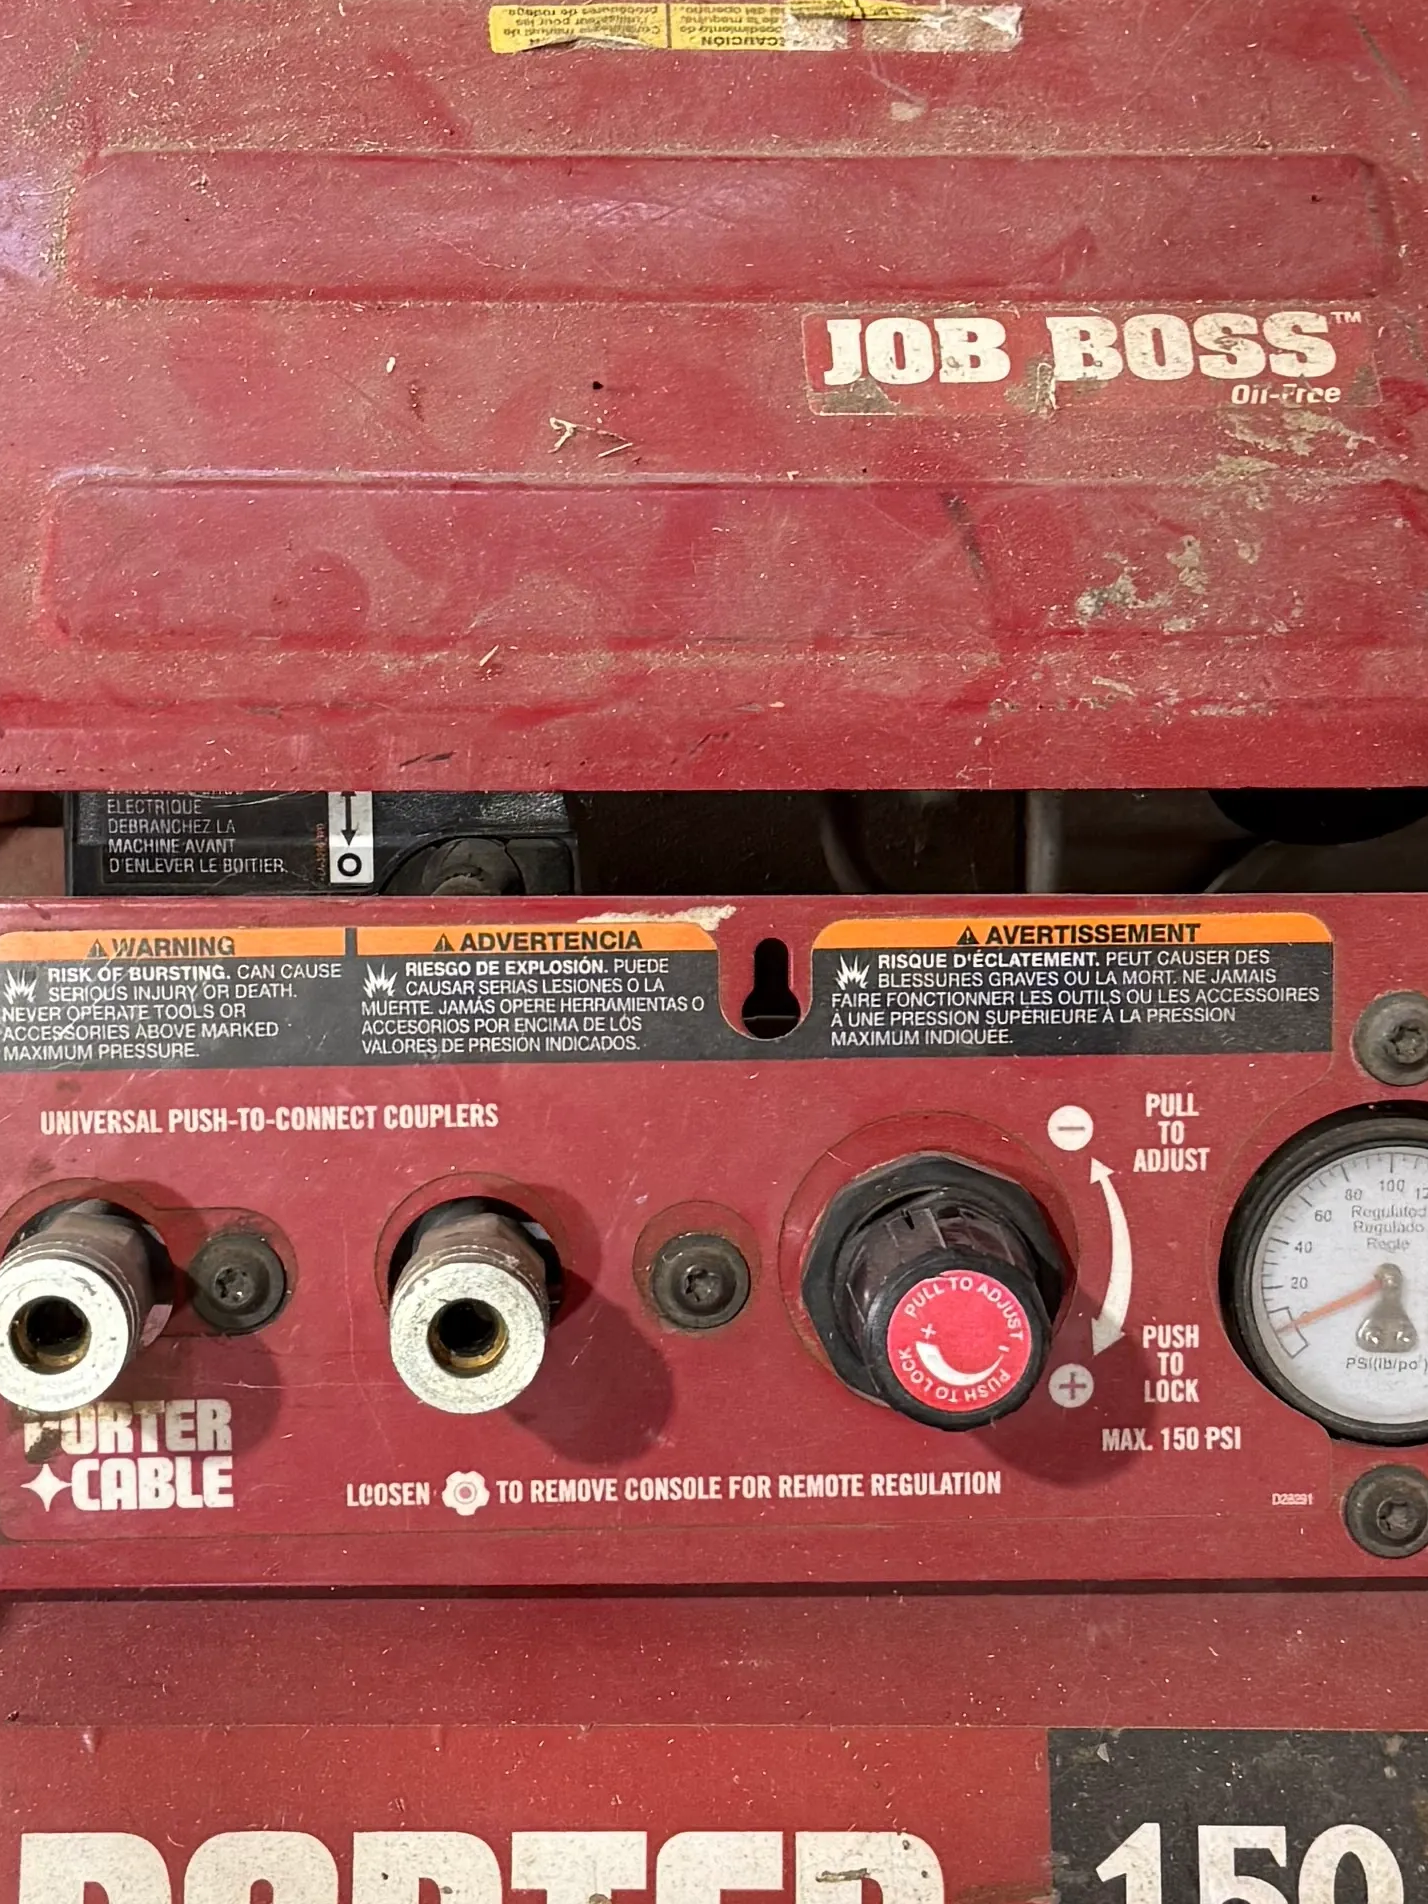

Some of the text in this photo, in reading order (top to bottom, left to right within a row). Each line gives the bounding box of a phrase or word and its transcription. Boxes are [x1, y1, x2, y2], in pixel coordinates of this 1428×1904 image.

[823, 316, 1011, 385] JOB
[108, 818, 236, 835] DEBRANCHEZ LA
[108, 838, 236, 854] MACHINE AVANT
[109, 857, 195, 873] D'ENLEVER
[199, 858, 218, 873] LE
[459, 931, 643, 952] ADVERTENCIA
[985, 923, 1201, 945] AVERTISSEMENT
[111, 936, 236, 957] WARNING
[405, 956, 669, 977] RIESGO DE EXPLOSIÓN. PUEDE
[878, 949, 1270, 969] RISQUE D'ÉCLATEMENT. PEUT CAUSER DES
[48, 963, 342, 983] RISK OF BURSTING. CAN CAUSE
[878, 968, 1277, 989] BLESSURES GRAVES OU LA MORT. NE JAMAIS
[48, 983, 297, 1002] SERIOUS INJURY OR DEATH.
[405, 978, 665, 995] CAUSAR SERIAS LESIONES O LA
[361, 996, 705, 1016] MUERTE. JAMÁS OPERE HERRAMIENTAS O
[831, 987, 1320, 1008] FAIRE FONCTIONNER LES OUTILS OU LES ACCESSOIRES
[2, 1003, 246, 1023] NEVER OPERATE TOOLS OR
[848, 1011, 885, 1027] UNE
[890, 1010, 980, 1026] PRESSION
[1120, 1008, 1141, 1023] LA
[1146, 1007, 1236, 1023] PRESSION
[2, 1022, 279, 1042] ACCESSORIES ABOVE MARKED
[361, 1019, 470, 1035] ACCESORIOS
[474, 1018, 510, 1034] POR
[514, 1017, 579, 1033] ENCIMA
[583, 1016, 606, 1032] DE
[362, 1038, 437, 1055] VALORES
[441, 1038, 465, 1054] DE
[545, 1034, 641, 1052] INDICADOS.
[831, 1030, 919, 1047] MAXIMUM
[3, 1043, 200, 1062] MAXIMUM PRESSURE.
[1145, 1093, 1198, 1117] PULL
[40, 1103, 499, 1136] UNIVERSAL PUSH-TO-CONNECT COUPLERS
[1158, 1121, 1185, 1145] TO
[1133, 1148, 1210, 1174] ADJUST
[1344, 1188, 1363, 1201] 80
[1379, 1179, 1405, 1193] 100
[1314, 1209, 1332, 1222] 60
[1351, 1205, 1427, 1220] Regulated
[1294, 1241, 1313, 1254] 40
[1291, 1277, 1308, 1290] 20
[904, 1276, 1024, 1341] PULL TO ADJUST
[1142, 1324, 1199, 1349] PUSH
[1157, 1352, 1184, 1376] TO
[898, 1346, 1011, 1403] PUSH TO LOCK
[1144, 1379, 1199, 1403] LOCK
[1102, 1426, 1242, 1452] MAX. 150 PSI
[71, 1456, 234, 1512] CABLE
[346, 1472, 1001, 1508] LOOSEN TO REMOVE CONSOLE FOR REMOTE REGULATION
